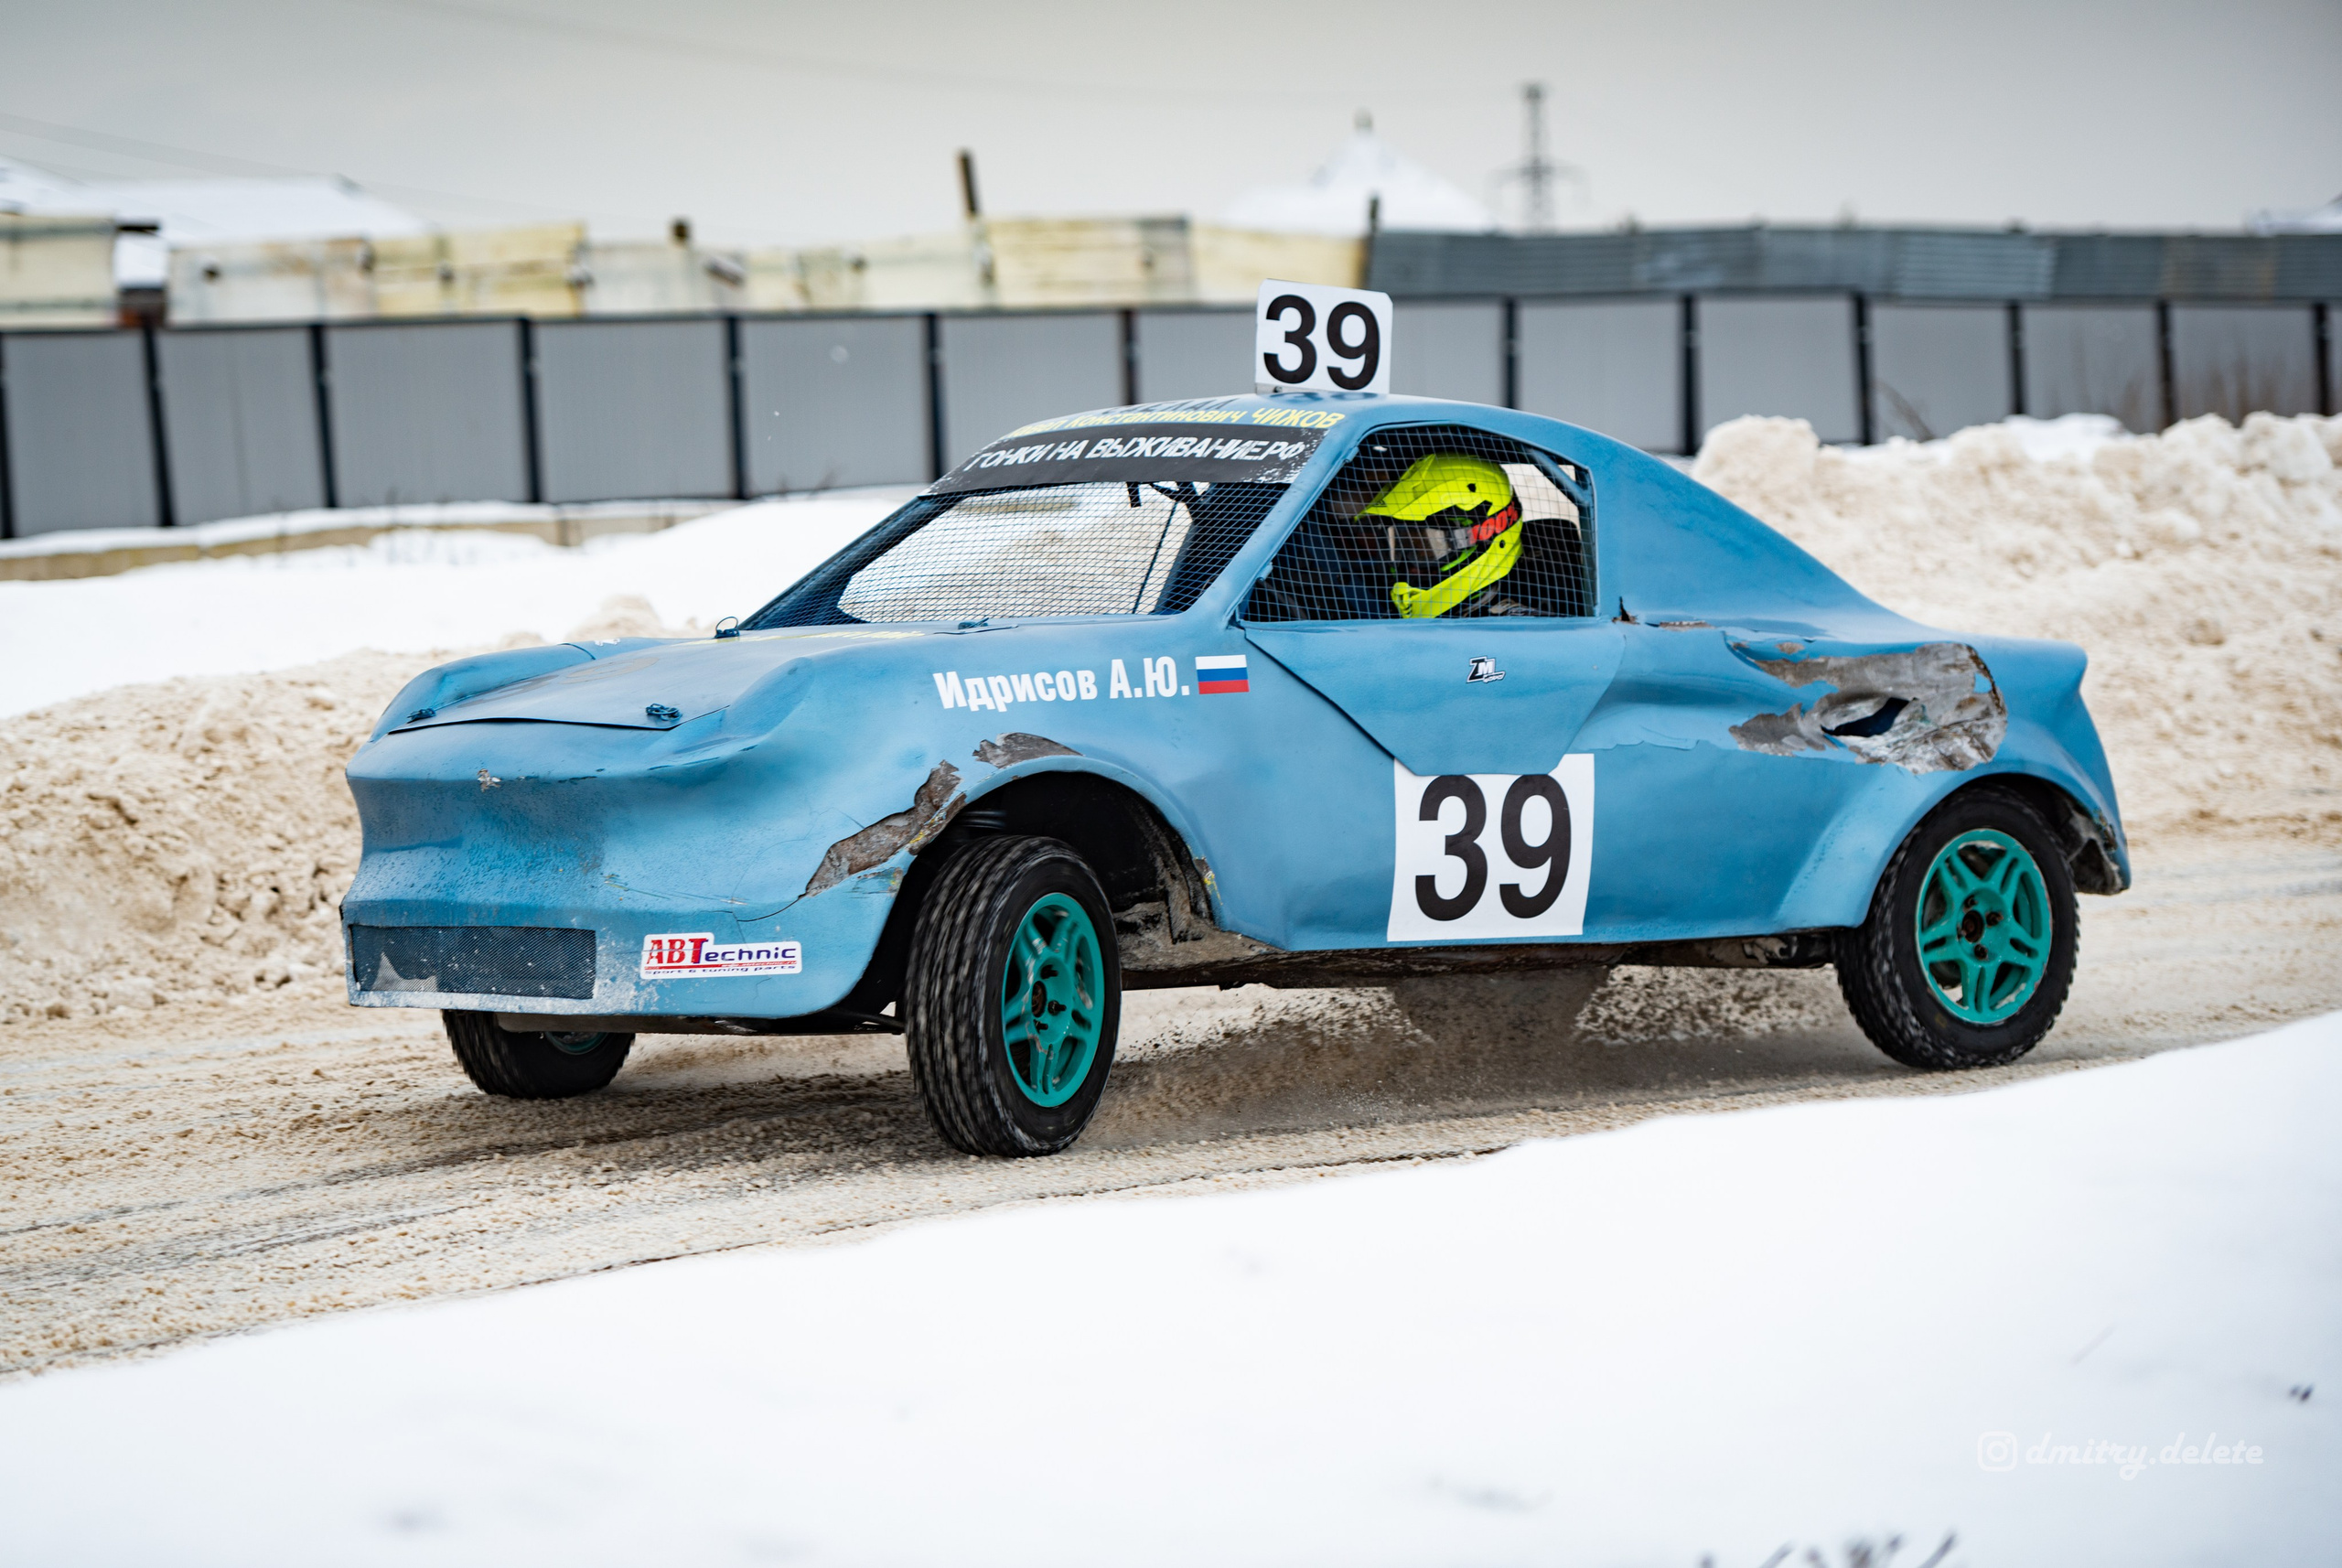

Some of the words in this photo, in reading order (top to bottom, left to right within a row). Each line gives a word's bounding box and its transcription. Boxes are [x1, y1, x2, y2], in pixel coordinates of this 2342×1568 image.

[1263, 295, 1380, 391] 39
[1252, 408, 1346, 428] ЧИЖОВ
[963, 443, 1055, 472] ГОНКИ
[1046, 439, 1090, 461] НА
[932, 670, 1098, 713] Идрисов
[1109, 656, 1190, 699] А.Ю.
[1415, 774, 1572, 922] 39
